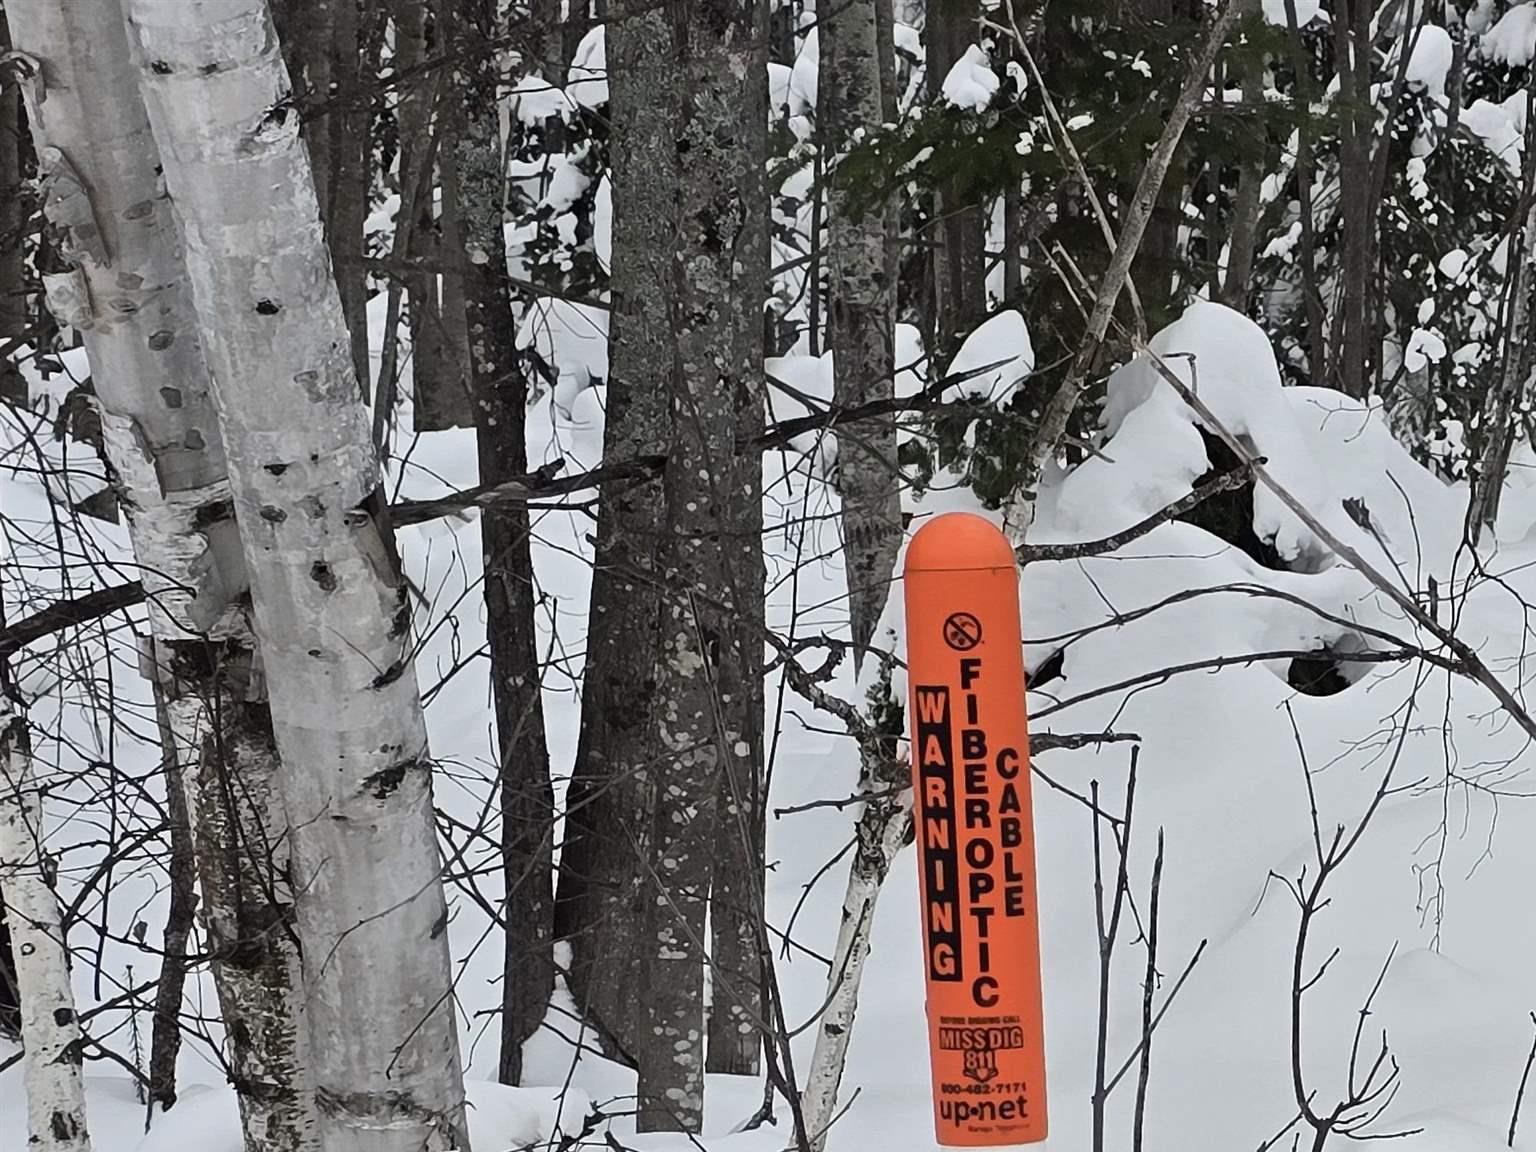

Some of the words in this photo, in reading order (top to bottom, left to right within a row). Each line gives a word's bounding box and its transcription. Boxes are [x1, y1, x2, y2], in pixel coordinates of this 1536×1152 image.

[917, 691, 956, 976] WARNING
[996, 747, 1025, 918] CABLE
[940, 1028, 986, 1050] MISS
[989, 1028, 1022, 1049] DIG
[966, 1051, 994, 1070] 811
